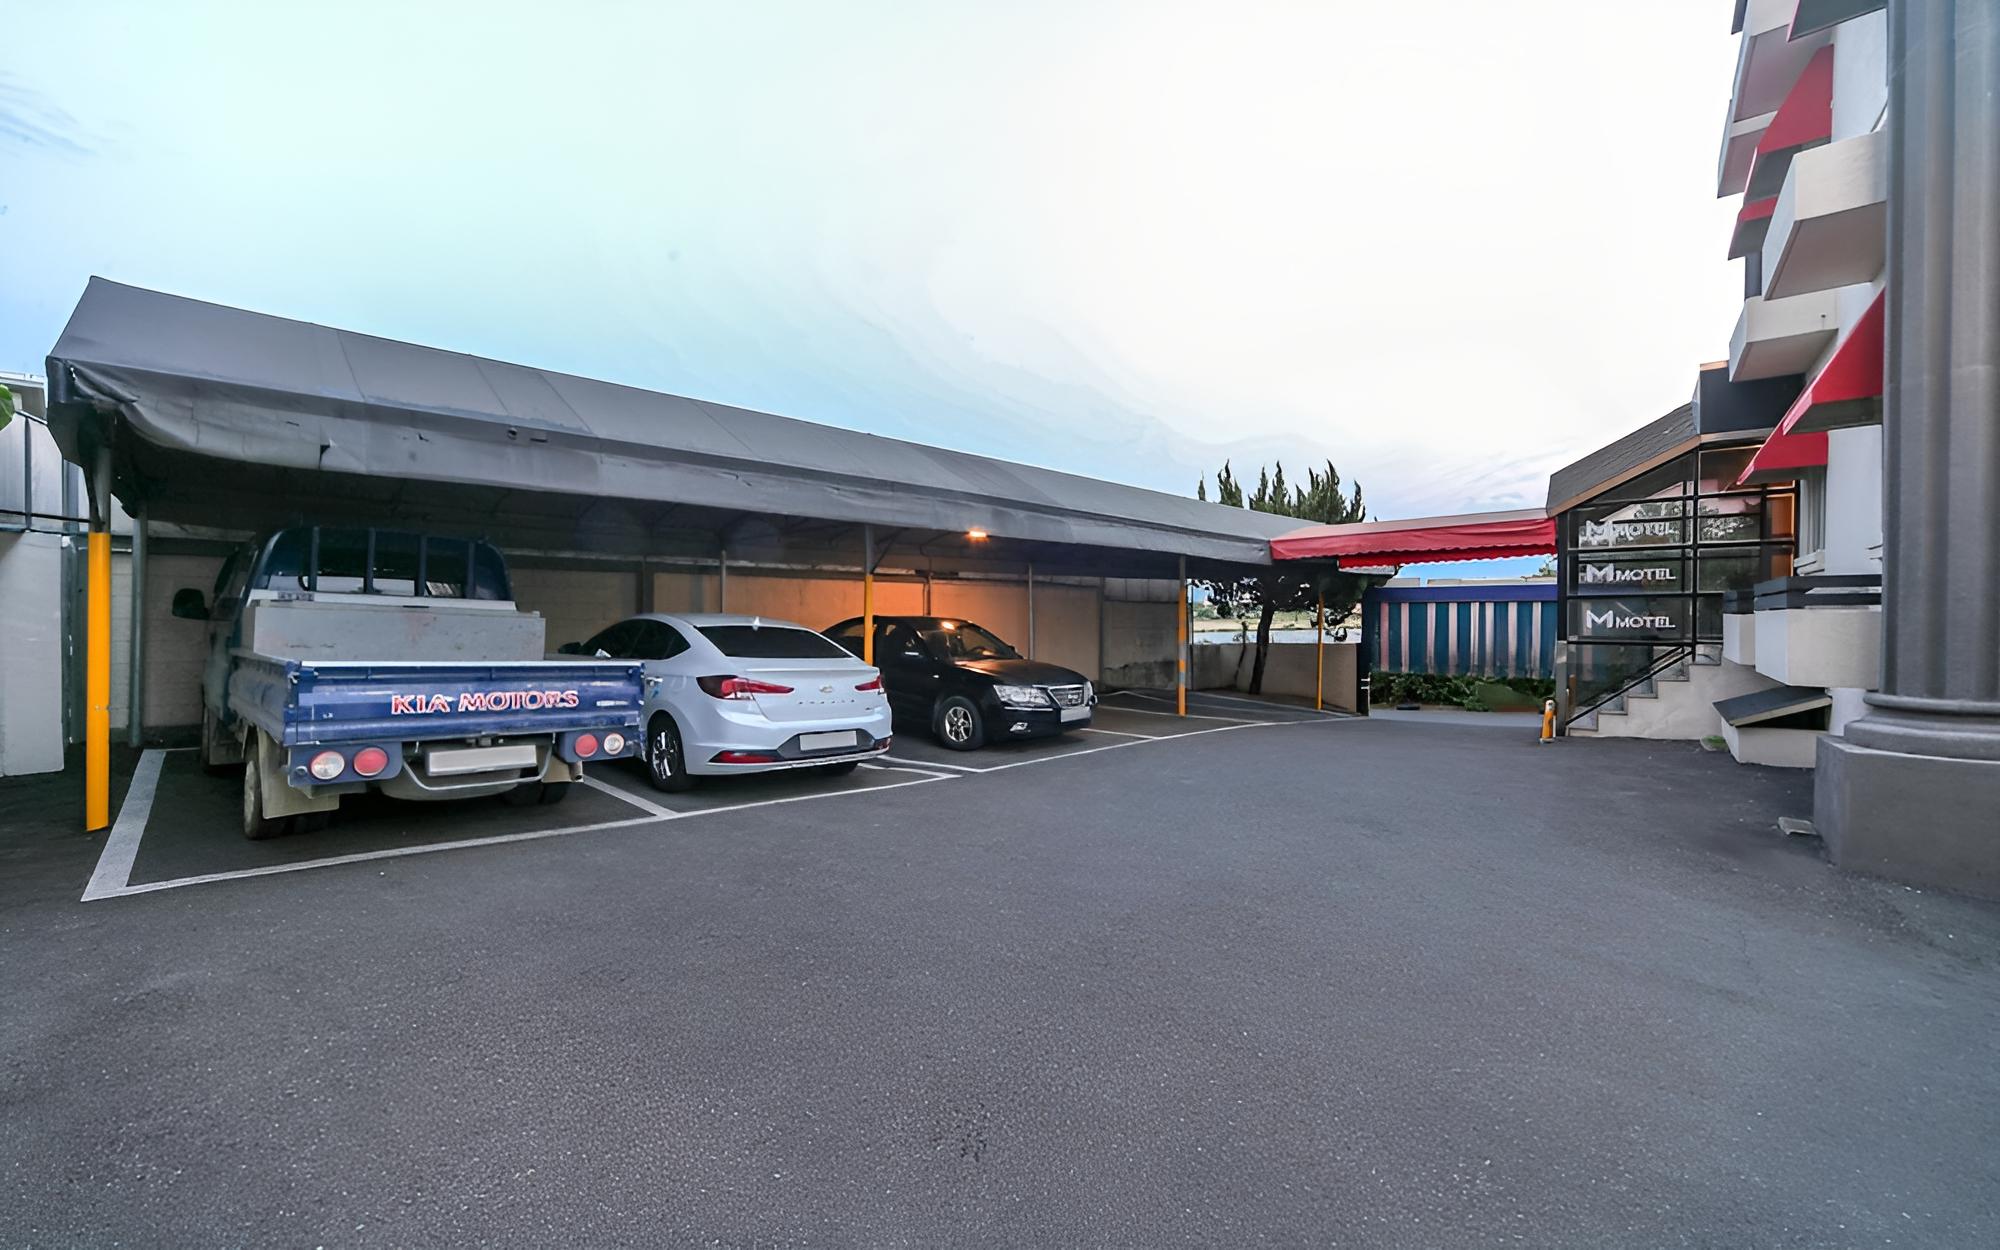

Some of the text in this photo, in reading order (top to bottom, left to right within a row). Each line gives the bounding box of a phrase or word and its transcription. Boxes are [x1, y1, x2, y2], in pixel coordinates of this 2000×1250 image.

[1615, 568, 1676, 581] MOTEL
[1616, 616, 1676, 628] MOTEL
[391, 690, 579, 714] KIA MOTORS
